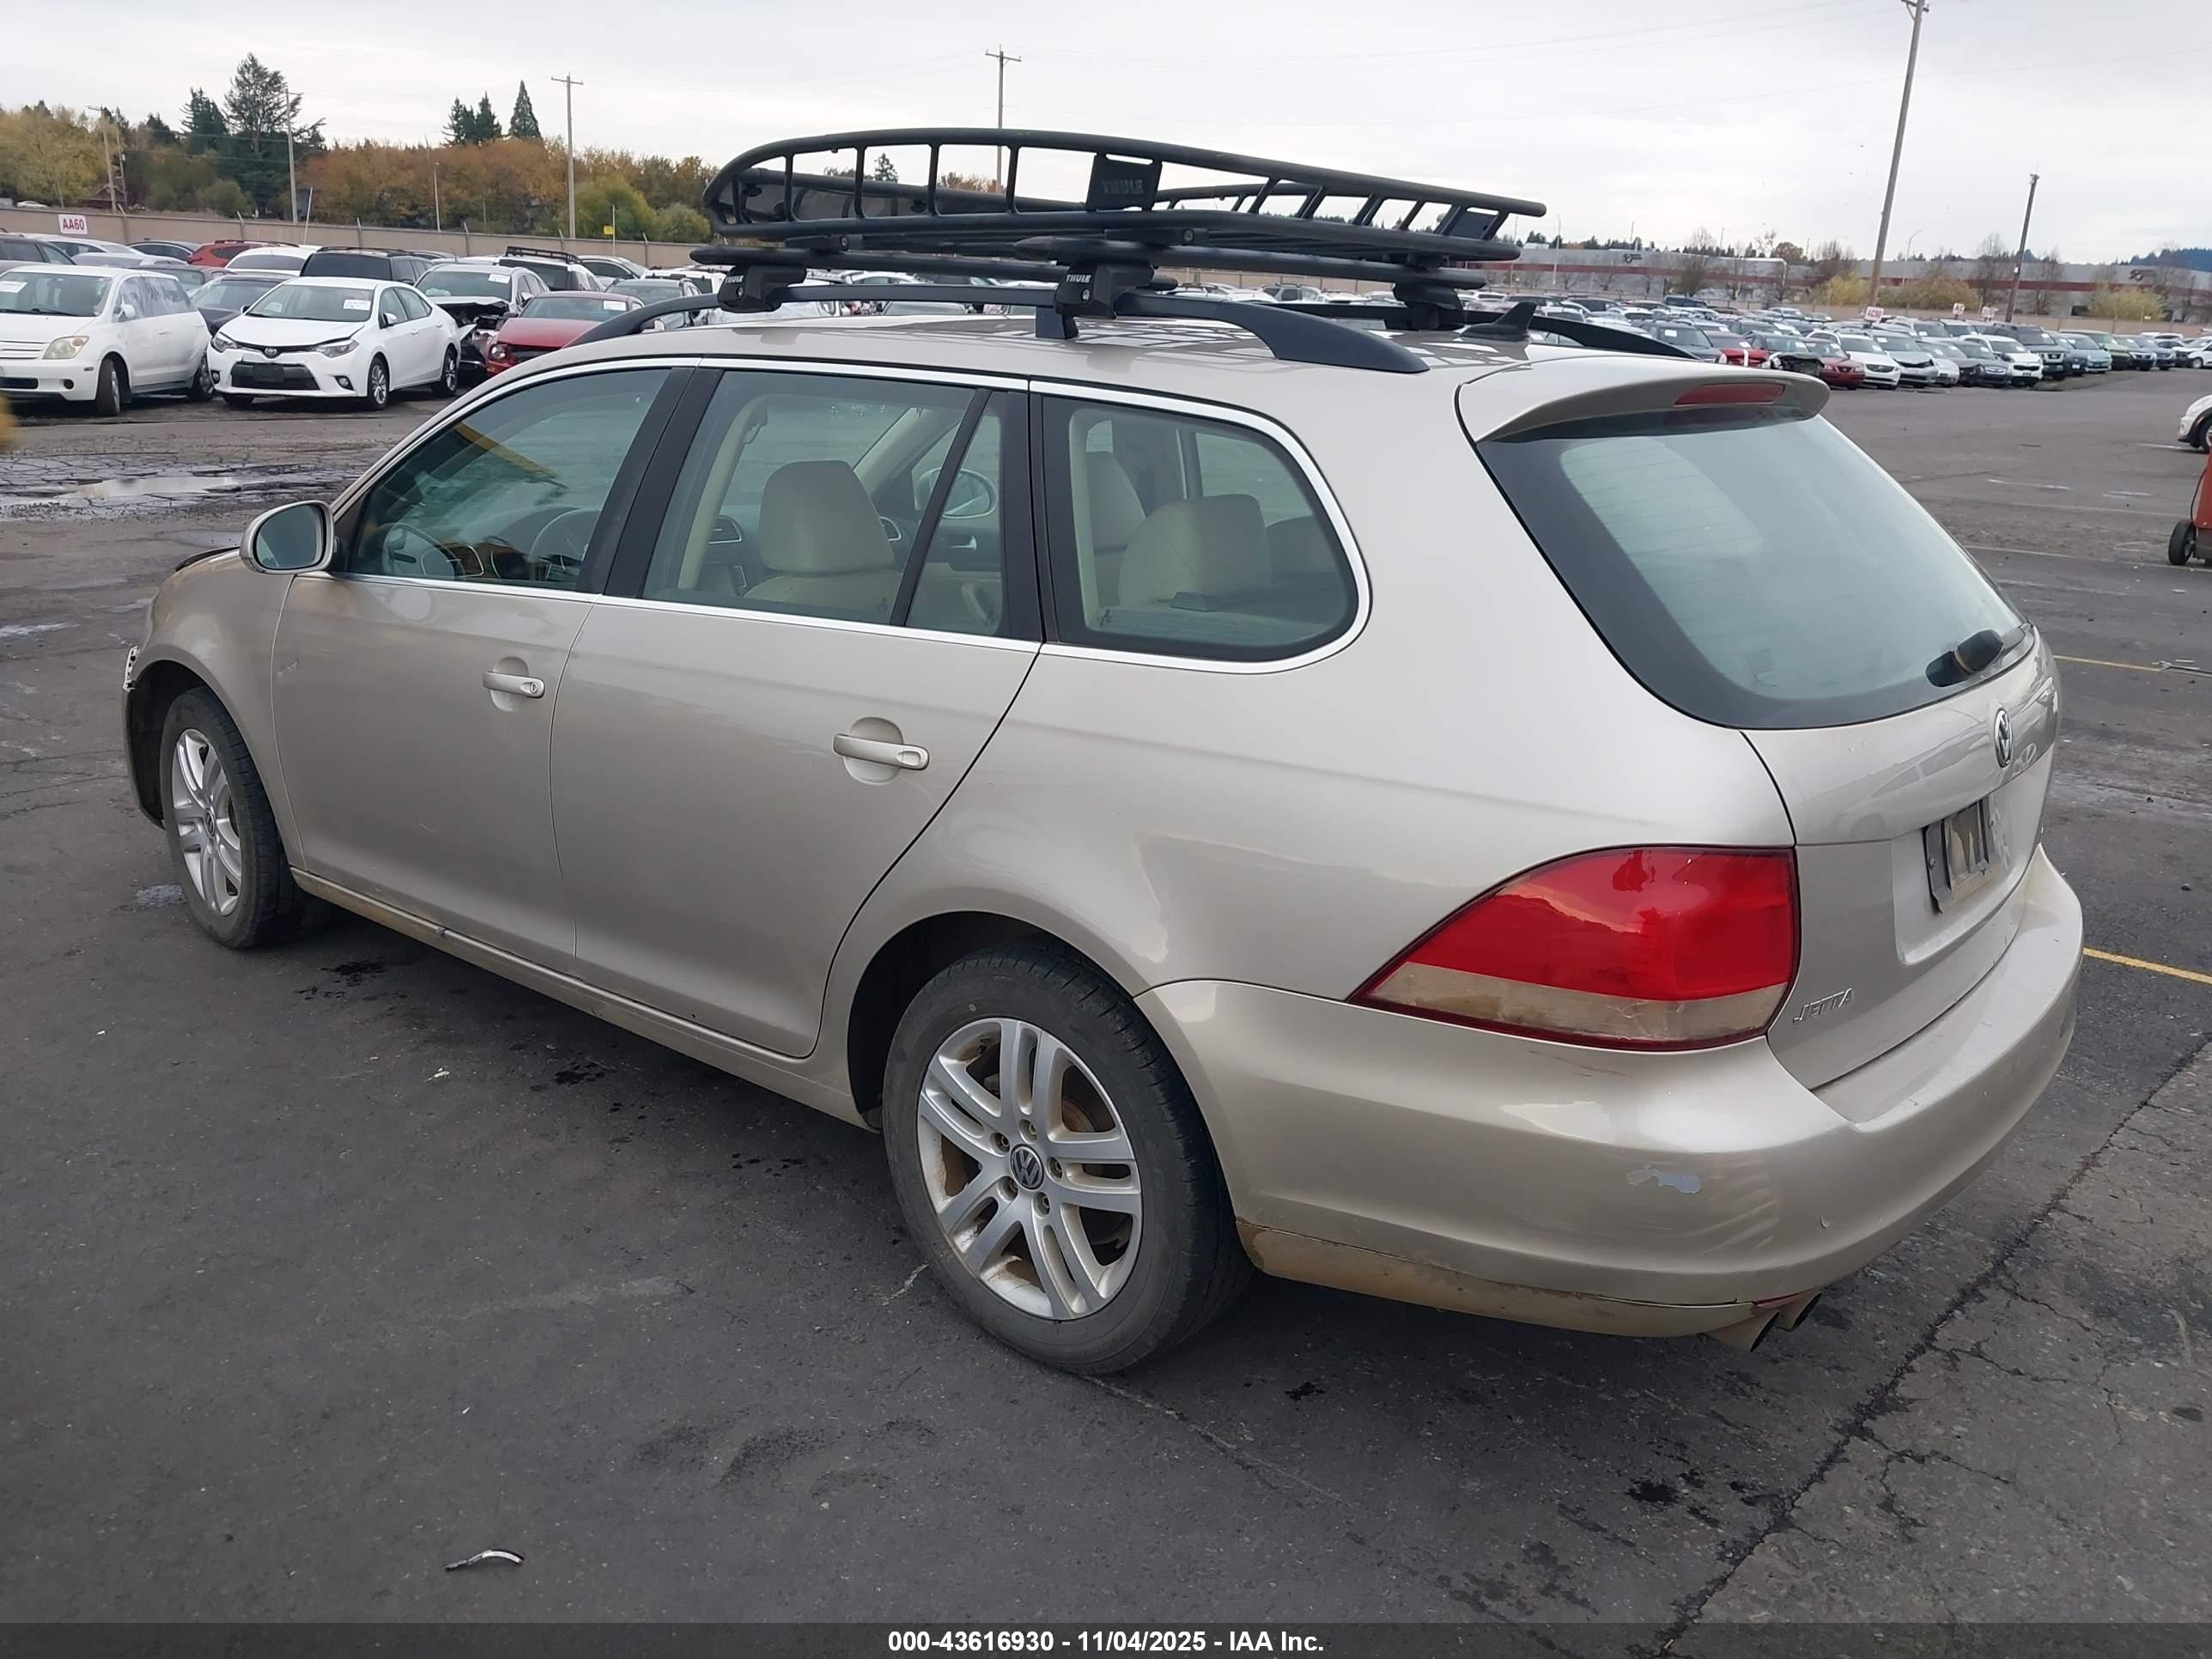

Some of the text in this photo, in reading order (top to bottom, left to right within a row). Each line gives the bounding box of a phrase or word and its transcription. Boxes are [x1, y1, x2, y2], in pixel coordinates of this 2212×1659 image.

[63, 217, 85, 230] AA60
[725, 275, 744, 283] THULE
[1066, 274, 1092, 283] THULE
[1792, 988, 1854, 1023] JETTA
[1012, 1146, 1044, 1188] VW
